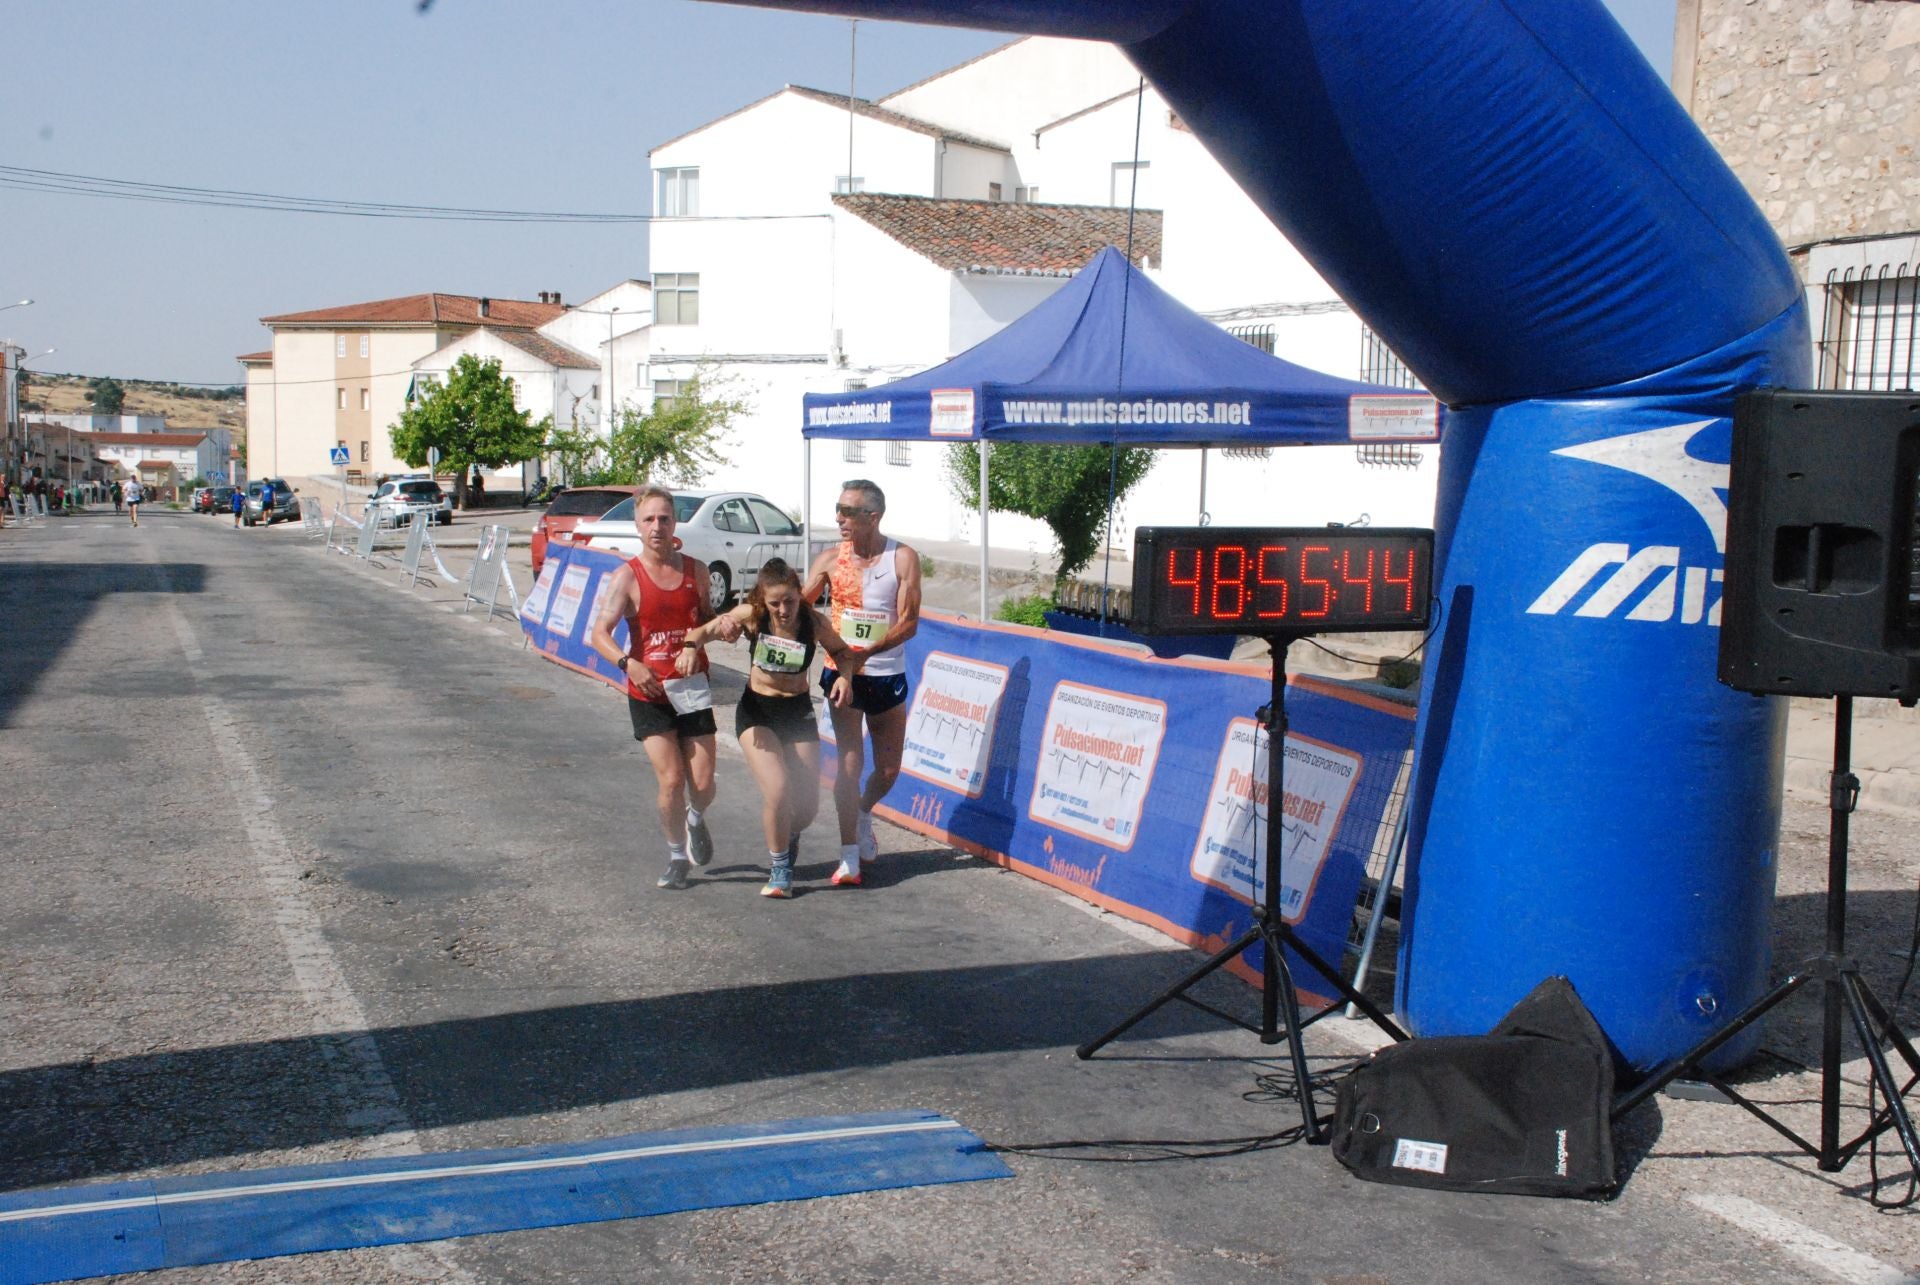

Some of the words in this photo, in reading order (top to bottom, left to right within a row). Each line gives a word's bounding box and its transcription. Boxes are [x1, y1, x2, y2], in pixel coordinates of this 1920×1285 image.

[809, 400, 892, 427] www.pulsaciones.net
[1002, 398, 1251, 426] www.pulsaciones.net
[1168, 545, 1415, 619] 48:55:44
[855, 623, 872, 639] 57
[767, 649, 787, 666] 63
[921, 687, 988, 724] Pulsaciones.net
[1093, 700, 1102, 711] DE
[1101, 701, 1126, 716] EVENTOS
[1125, 707, 1161, 724] DEPORTIVOS
[1053, 723, 1146, 767] Pulsaciones.net
[1310, 755, 1353, 778] DEPORTIVOS
